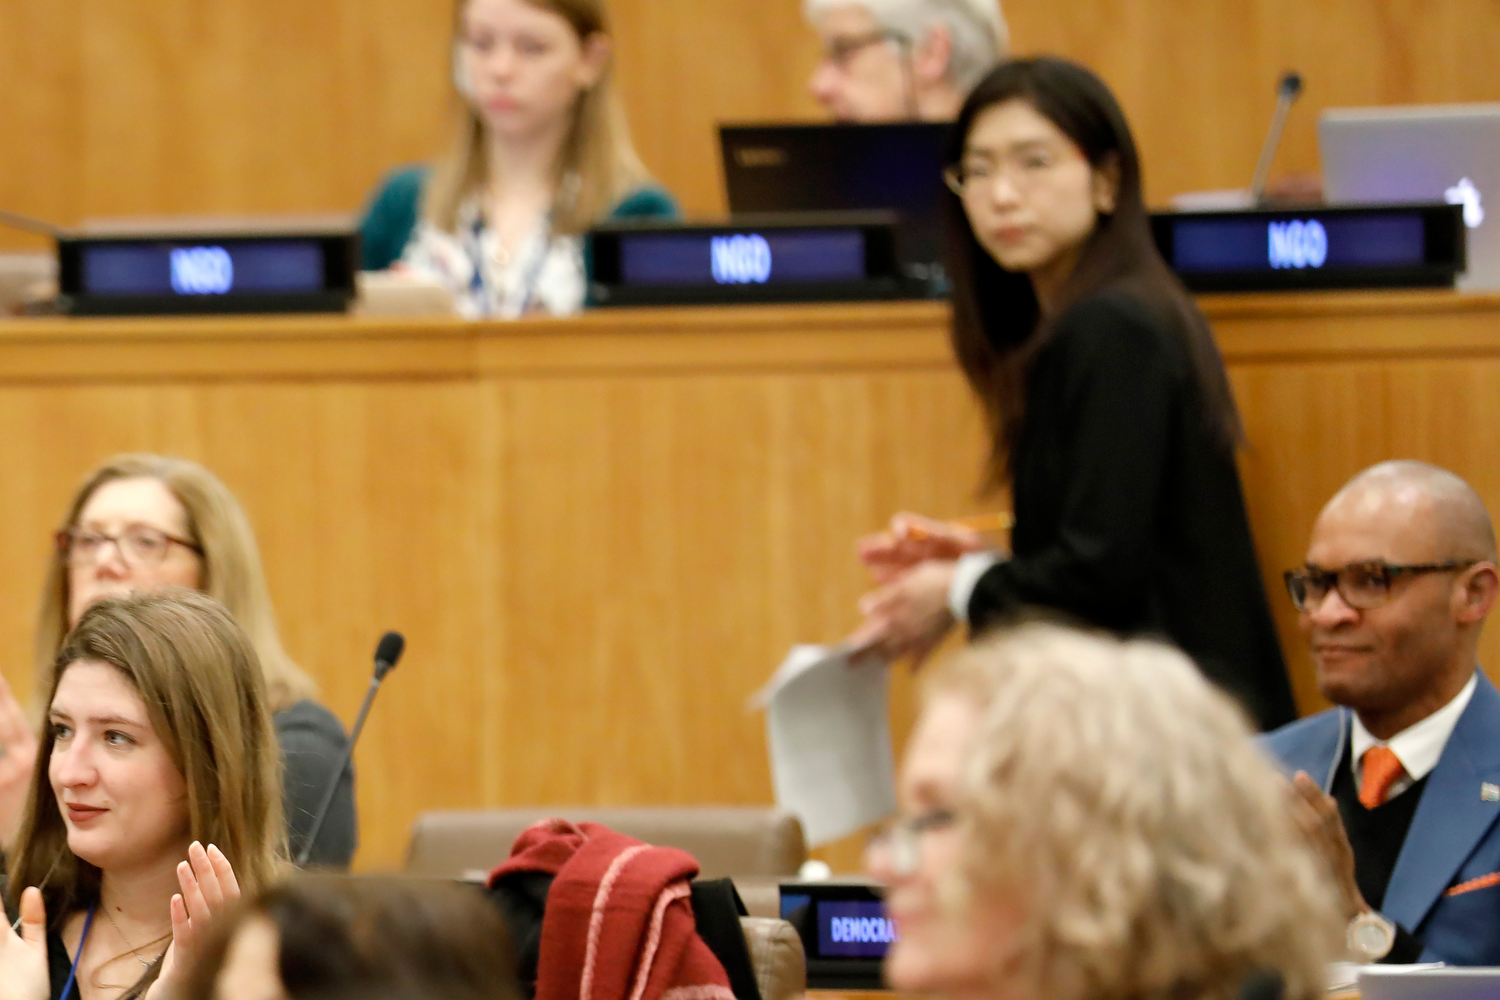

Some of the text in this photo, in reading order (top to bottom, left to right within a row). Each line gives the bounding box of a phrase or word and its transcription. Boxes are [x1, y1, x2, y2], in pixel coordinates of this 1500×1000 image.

[711, 235, 772, 283] NGO
[1268, 221, 1327, 268] NGO
[171, 247, 233, 294] NGO
[831, 916, 898, 942] DEMOCRA
